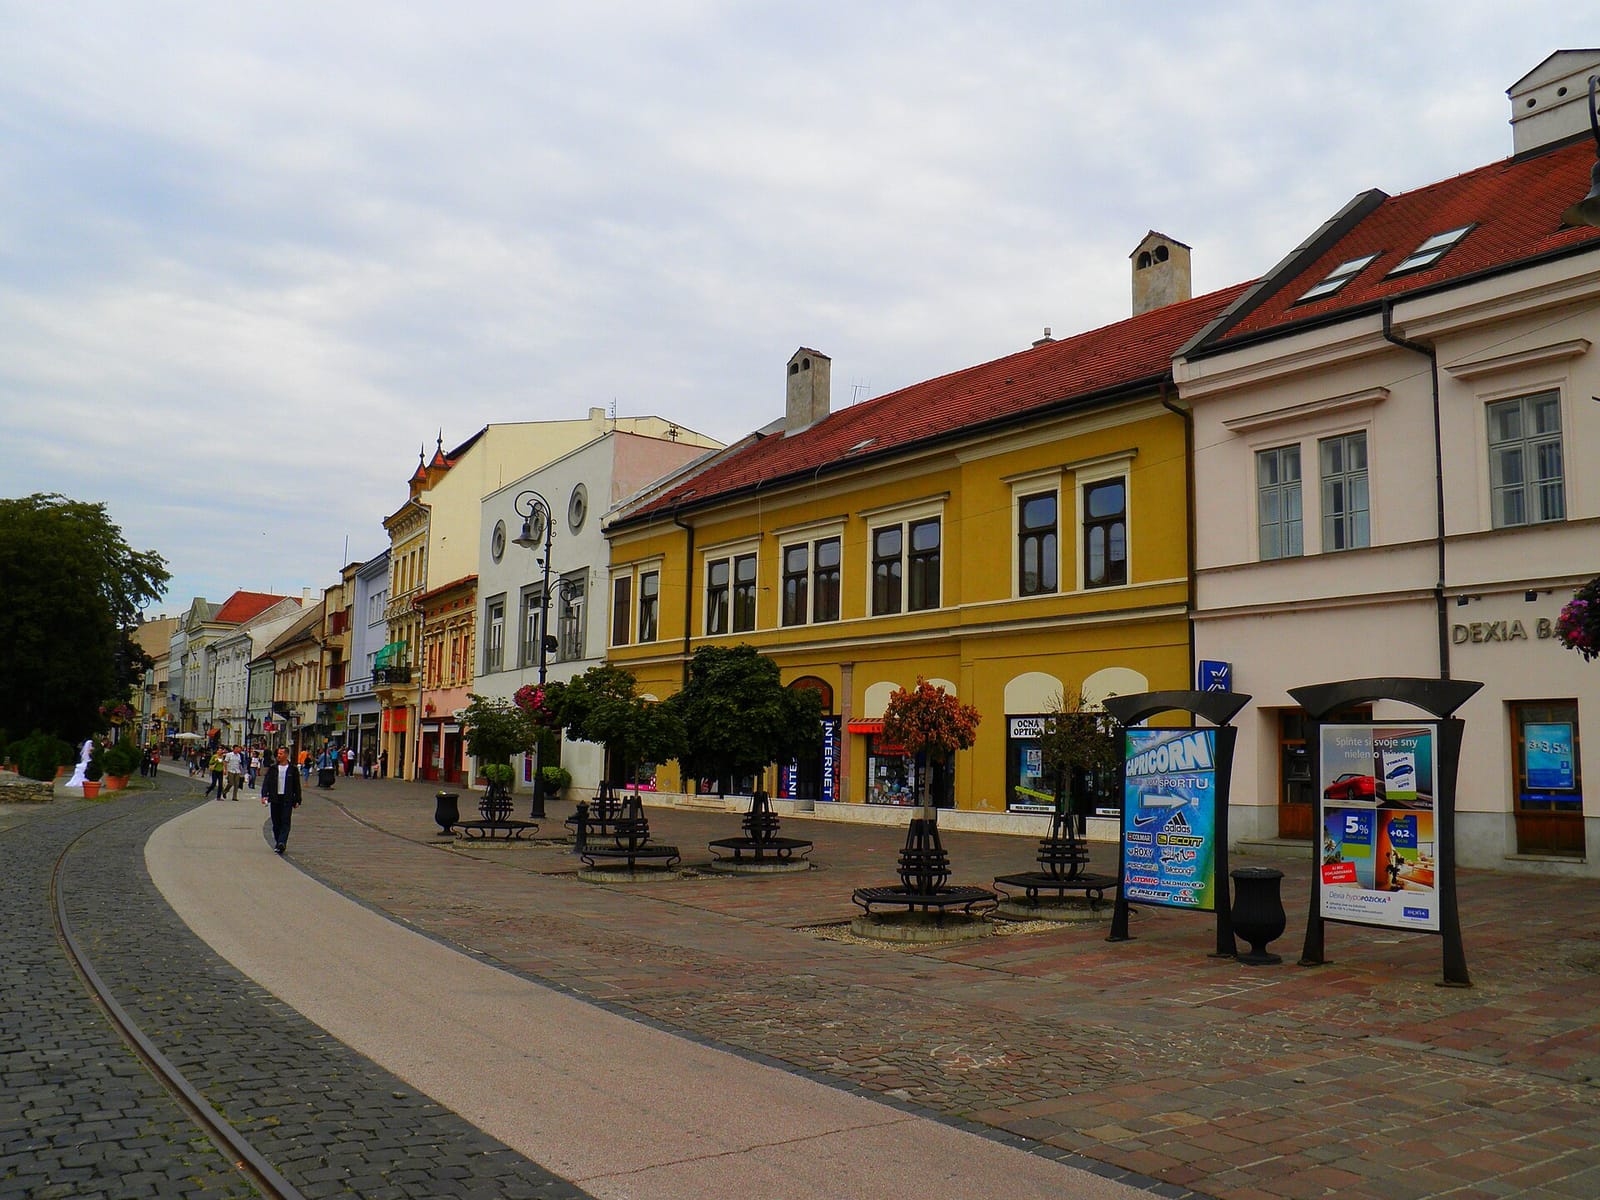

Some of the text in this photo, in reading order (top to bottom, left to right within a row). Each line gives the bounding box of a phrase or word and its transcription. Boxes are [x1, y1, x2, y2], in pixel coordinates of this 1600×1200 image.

[1453, 619, 1527, 644] DEXIA
[1364, 738, 1372, 746] si
[1374, 737, 1400, 748] svoje
[1401, 739, 1418, 749] sny
[824, 722, 833, 797] INTERNET
[1126, 731, 1211, 777] CAPRICORN
[1344, 750, 1371, 759] nielen
[1159, 778, 1209, 789] SPORTU
[1164, 825, 1190, 833] adidas
[1169, 835, 1203, 847] SCOTT
[1134, 848, 1153, 857] ROXY
[1132, 876, 1158, 885] ATOMIC
[1137, 889, 1170, 898] PROTEST
